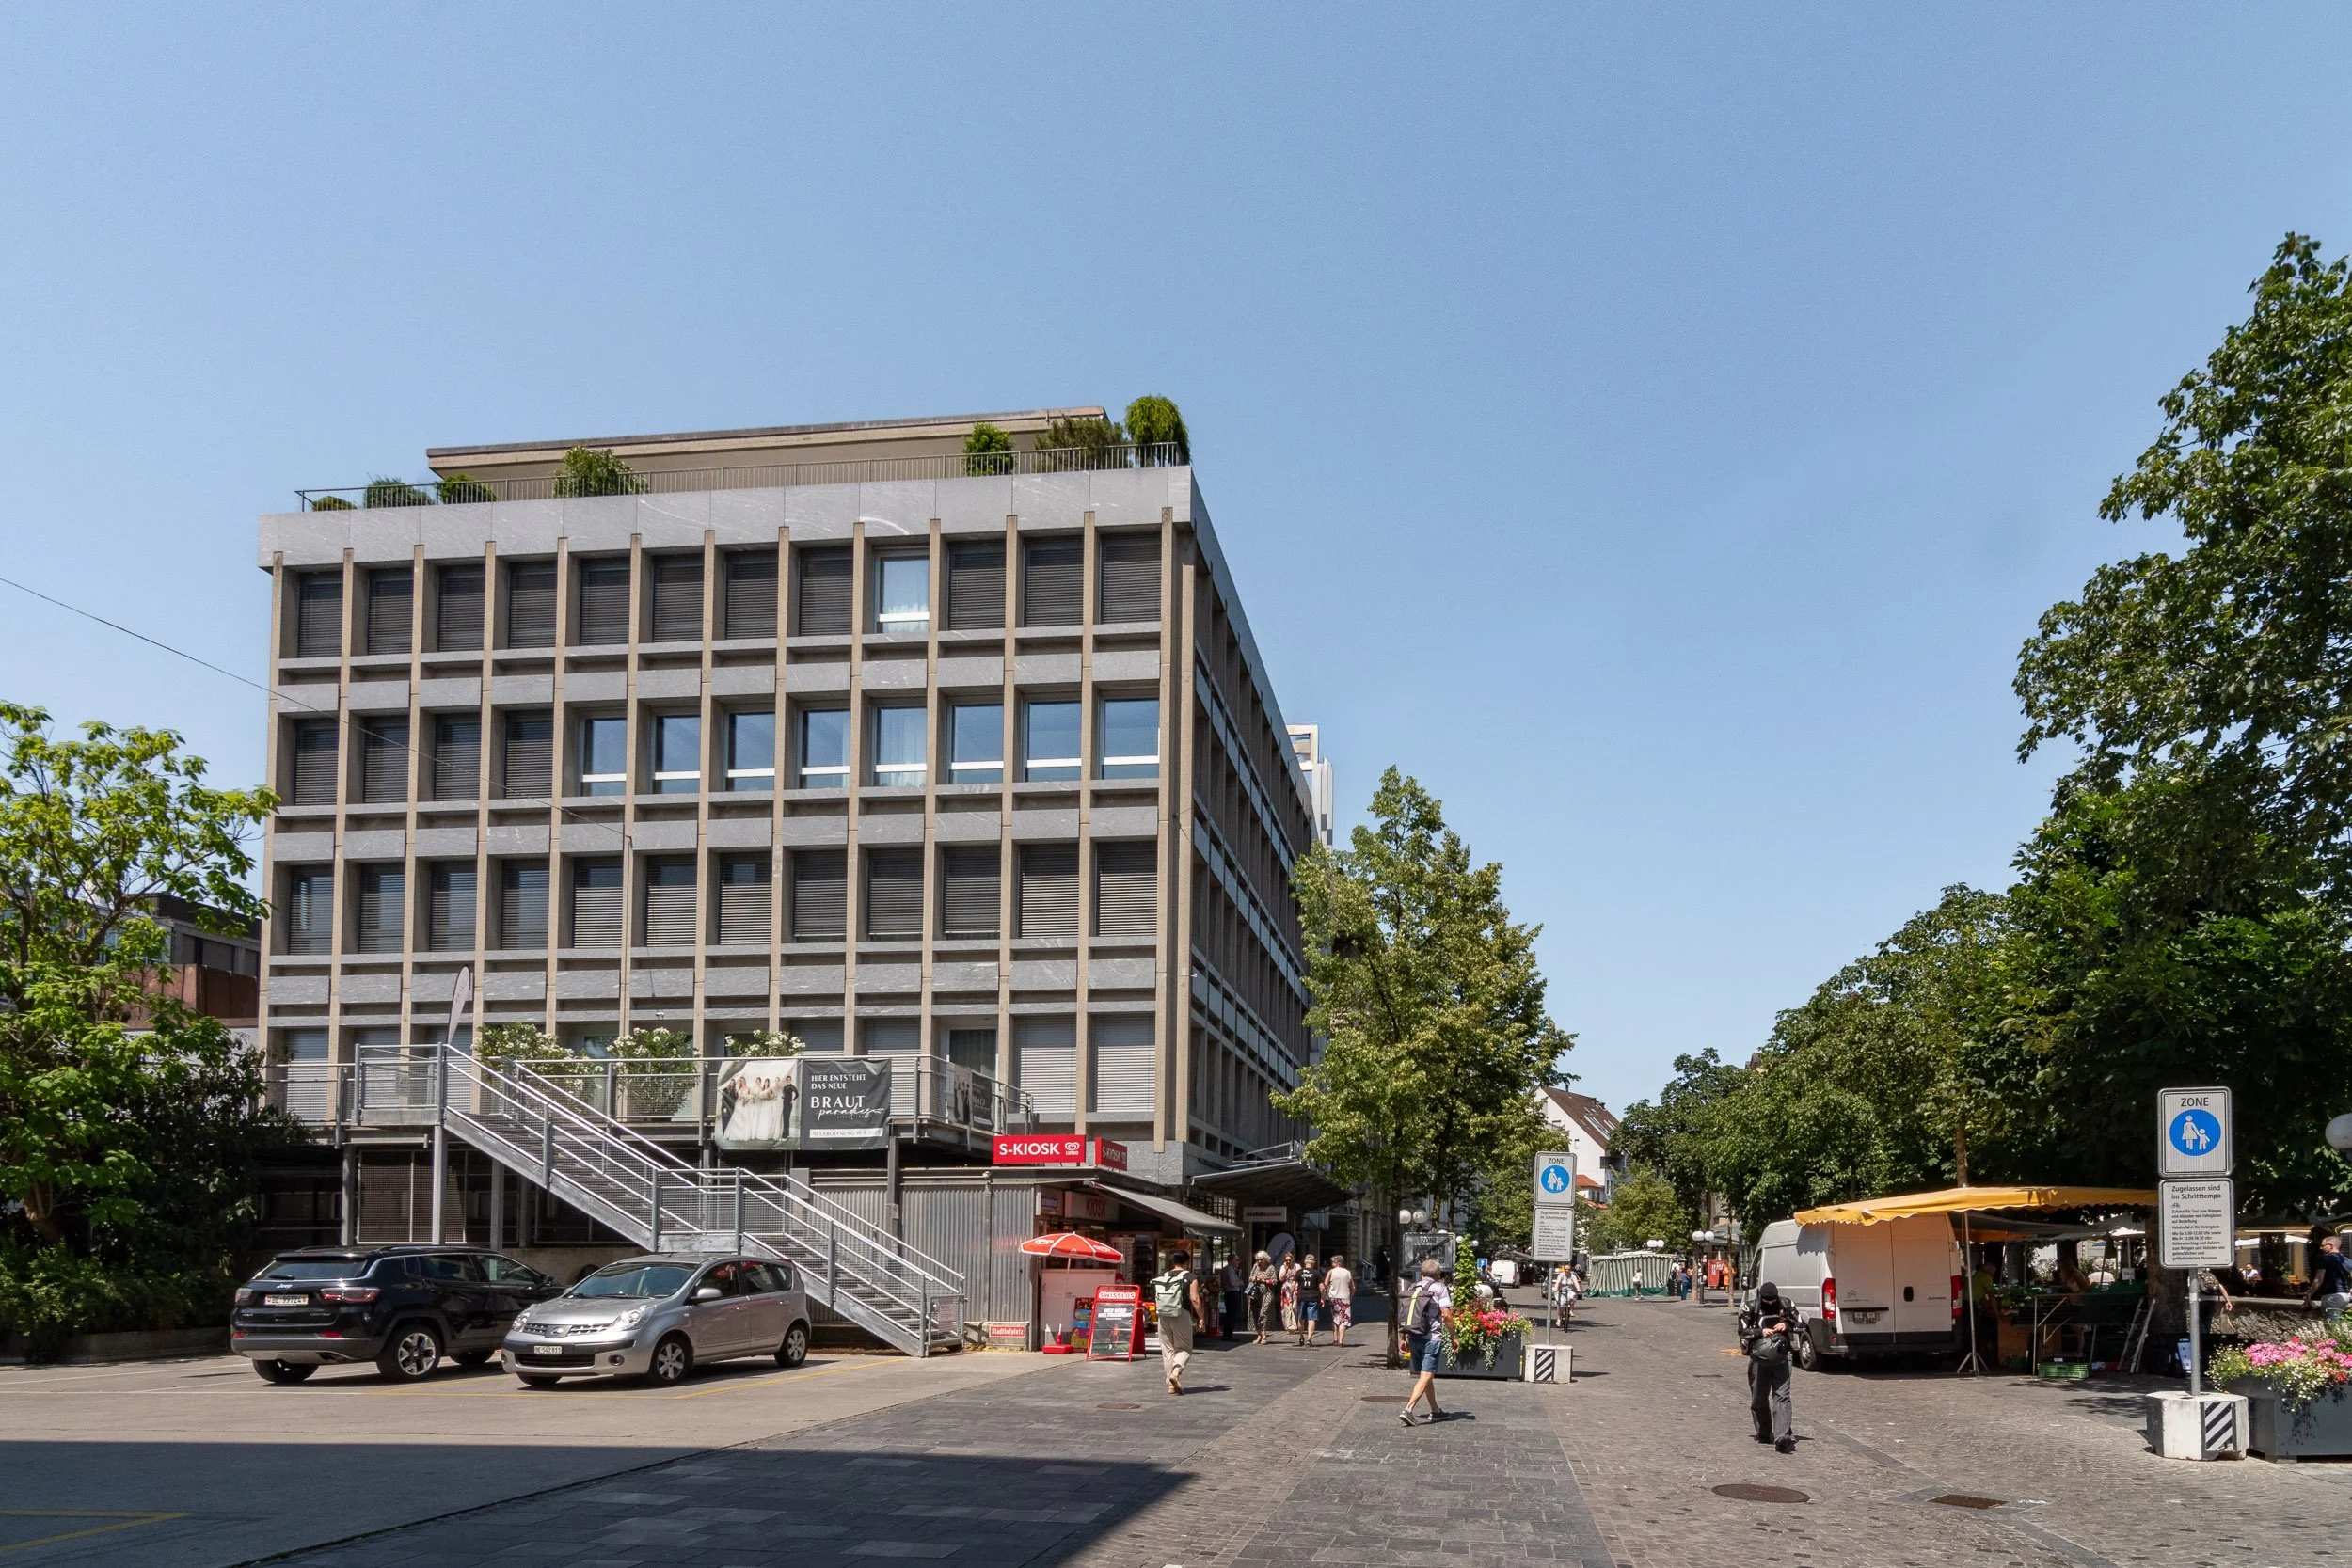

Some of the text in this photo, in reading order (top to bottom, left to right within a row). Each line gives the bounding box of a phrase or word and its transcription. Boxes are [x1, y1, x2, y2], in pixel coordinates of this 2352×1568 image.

[829, 1073, 866, 1082] ENTSTEHT
[810, 1095, 866, 1109] BRAUT
[2180, 1097, 2209, 1107] ZONE
[818, 1102, 883, 1121] paradies
[999, 1142, 1060, 1156] S-KIOSK
[2171, 1185, 2206, 1194] Zugelassen
[1086, 1196, 1106, 1218] KIOSK
